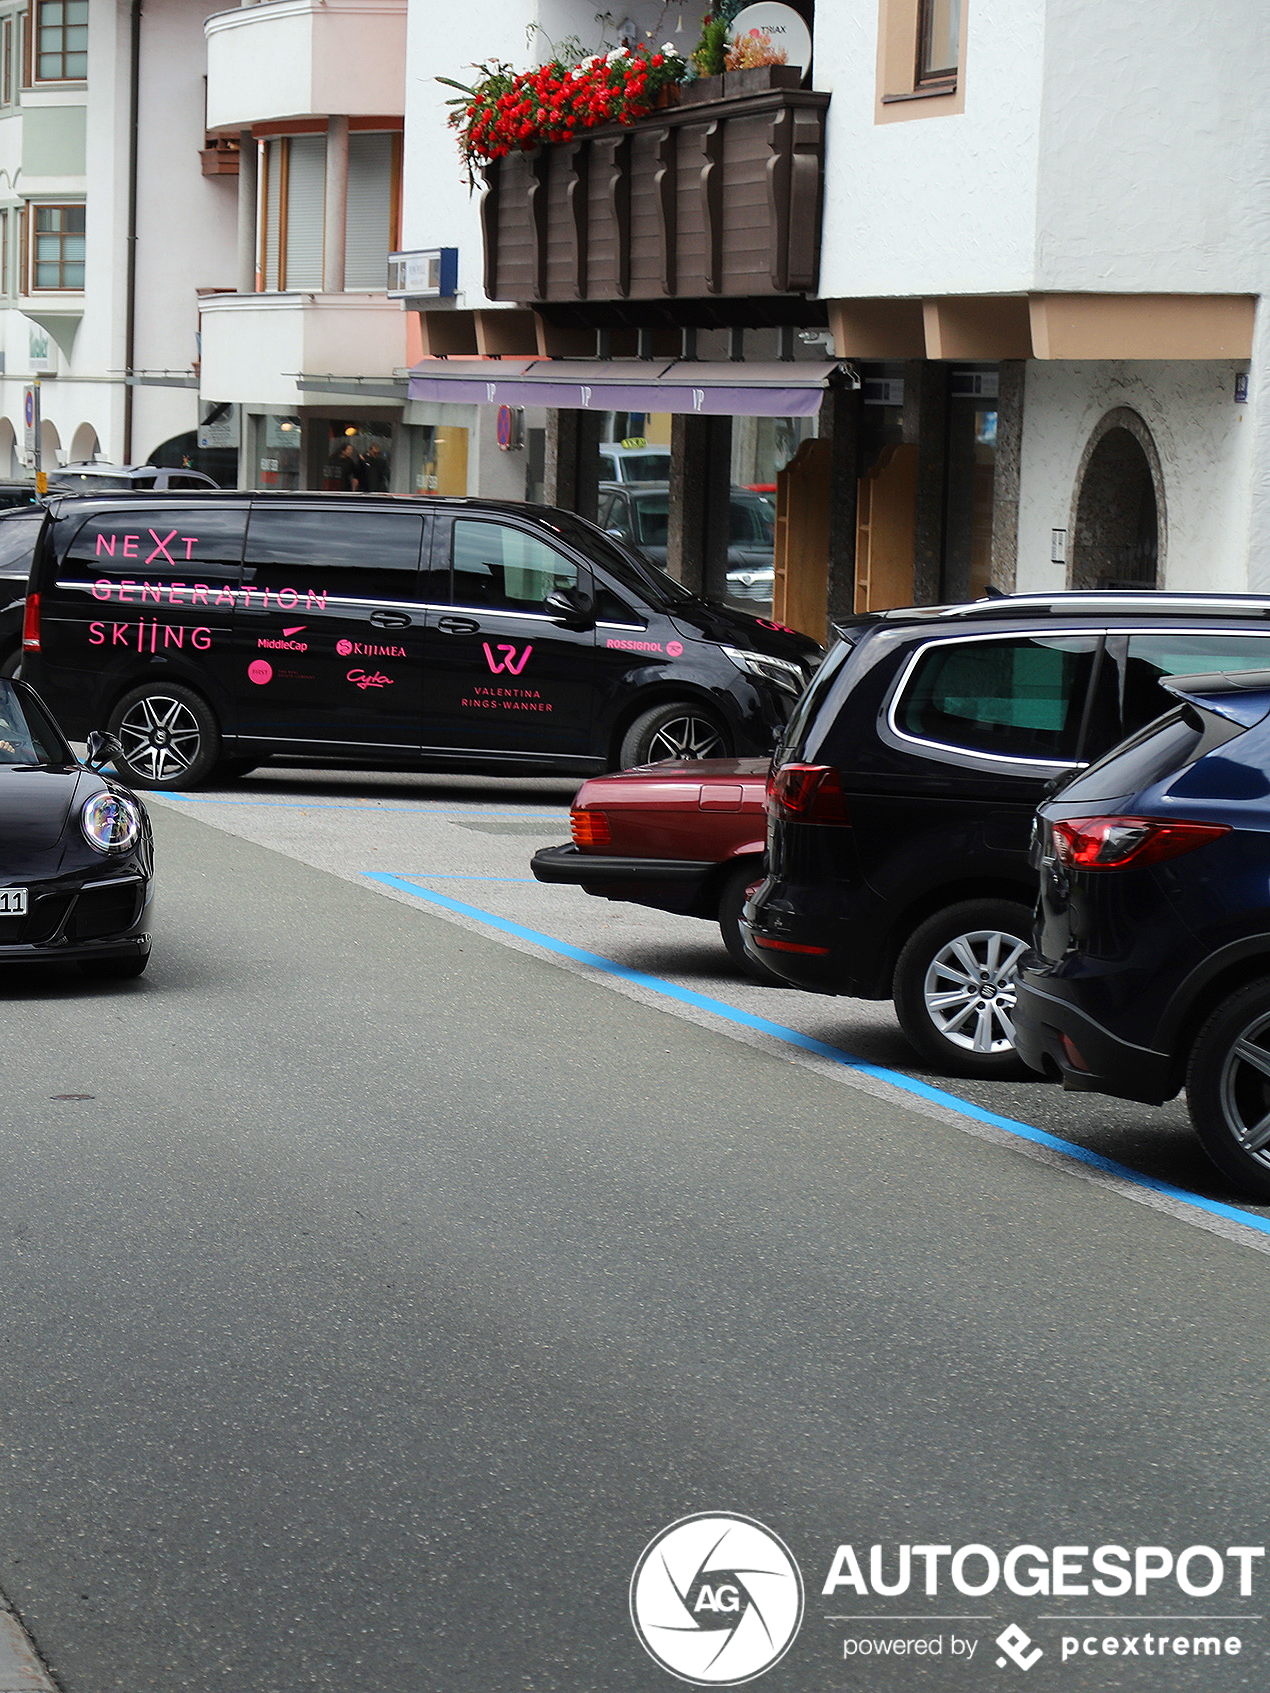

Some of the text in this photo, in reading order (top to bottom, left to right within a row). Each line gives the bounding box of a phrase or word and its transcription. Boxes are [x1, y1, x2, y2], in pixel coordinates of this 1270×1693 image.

[95, 528, 199, 566] NEXT
[91, 579, 328, 611] GENERATION
[257, 638, 308, 653] MiddleCap
[353, 642, 407, 658] KIJIMEA
[473, 686, 541, 699] VALENTINA
[461, 698, 553, 712] RINGS-WANNER
